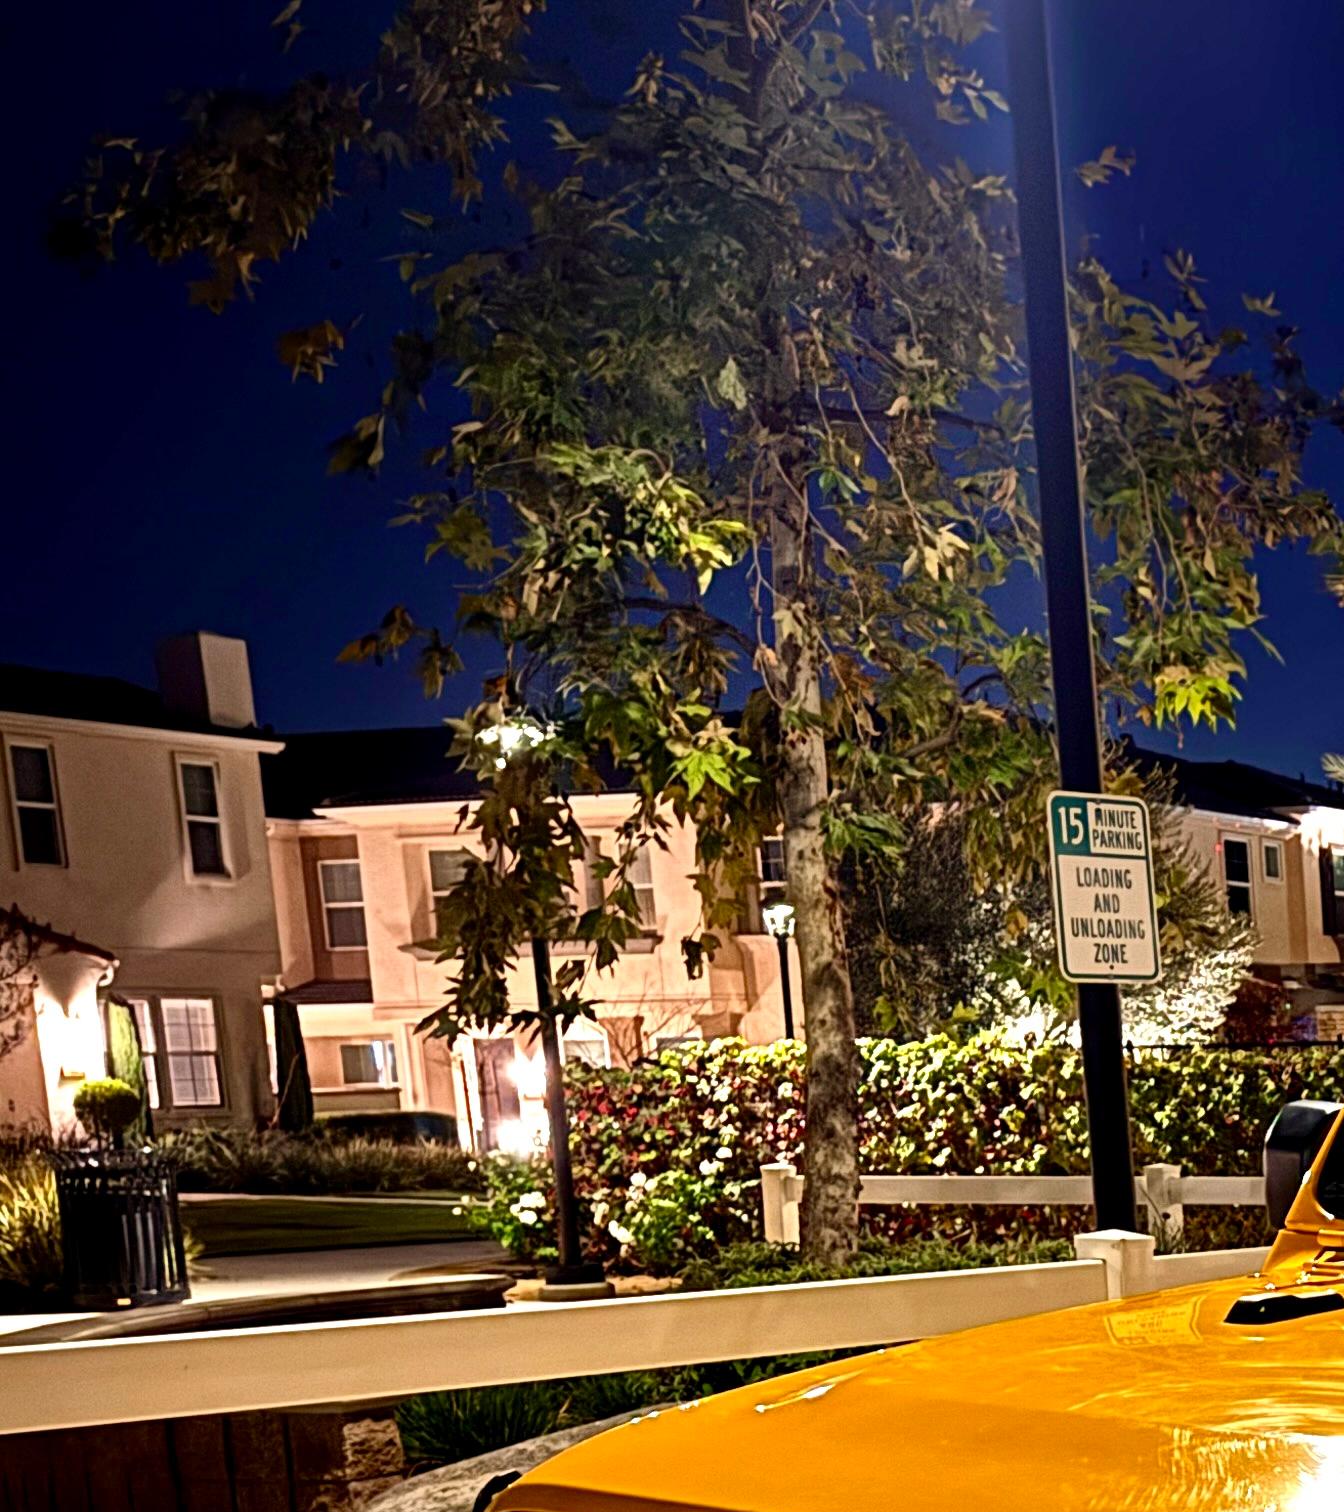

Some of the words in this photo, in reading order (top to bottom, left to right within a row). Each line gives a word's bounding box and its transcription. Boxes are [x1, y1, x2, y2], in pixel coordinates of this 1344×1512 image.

[1057, 806, 1084, 845] 15
[1094, 808, 1137, 829] MINUTE
[1092, 829, 1142, 850] PARKING
[1076, 867, 1132, 889] LOADING
[1094, 893, 1120, 914] AND
[1071, 917, 1145, 939] UNLOADING
[1094, 943, 1128, 964] ZONE
